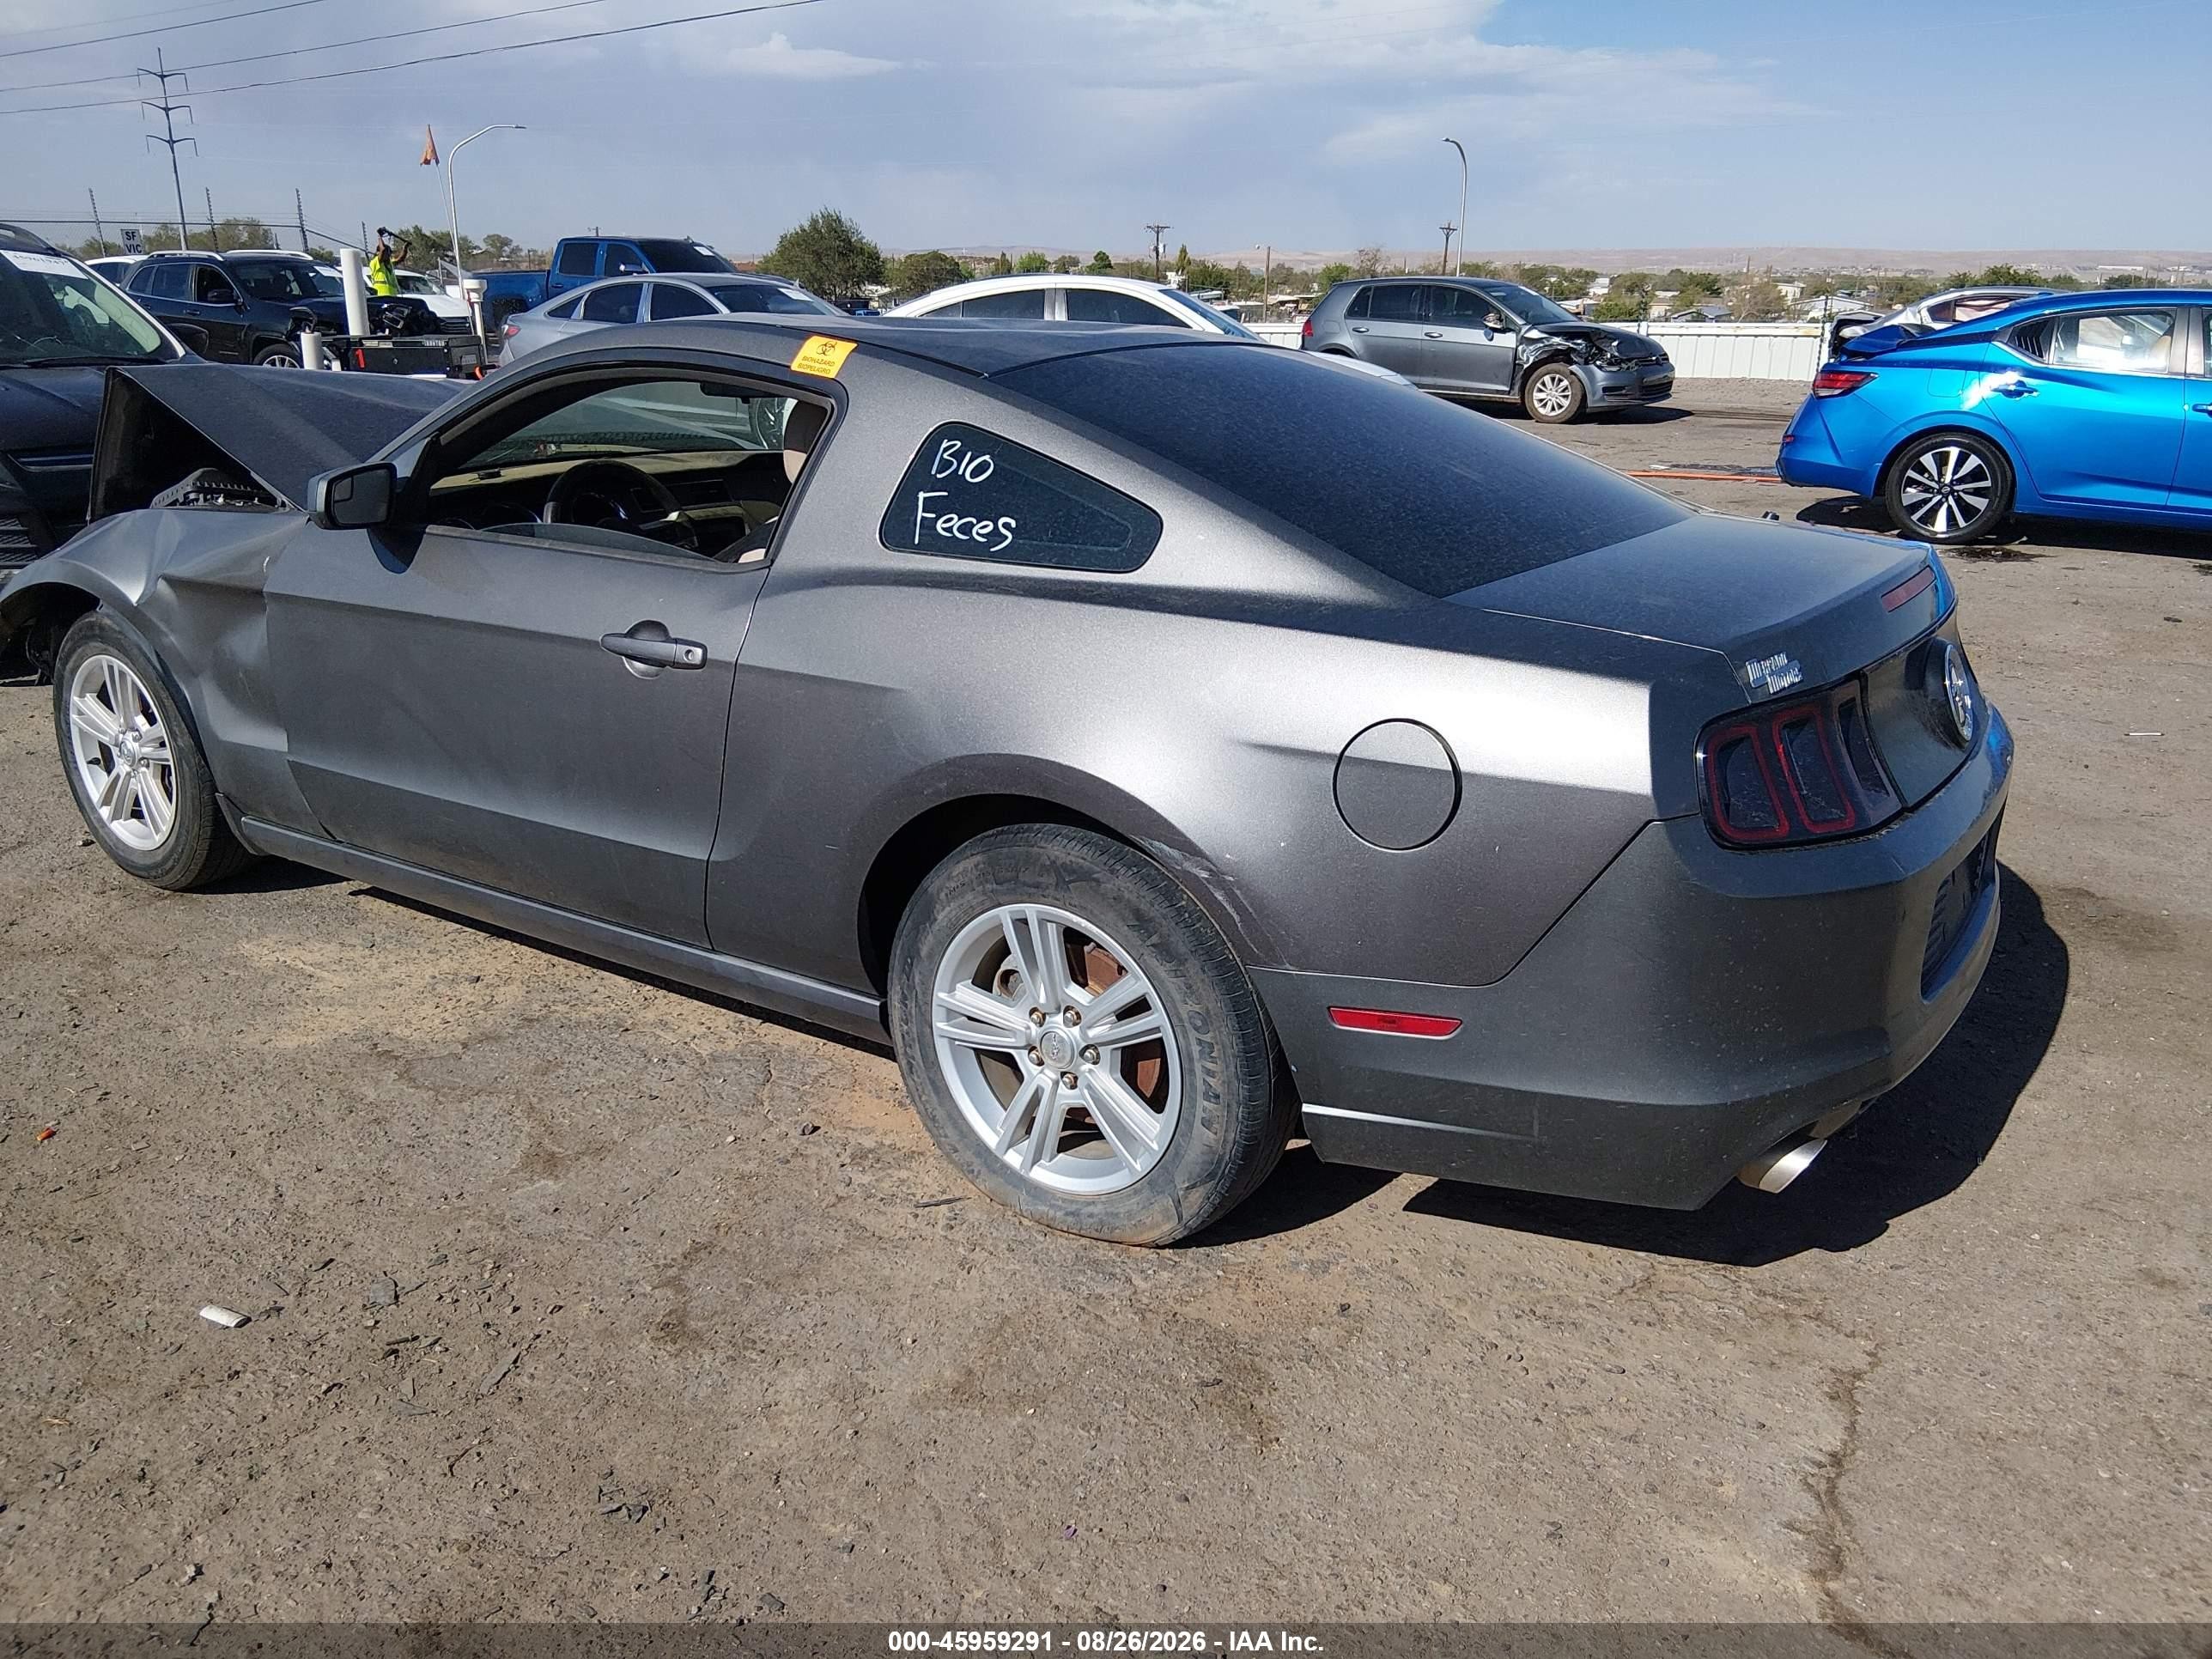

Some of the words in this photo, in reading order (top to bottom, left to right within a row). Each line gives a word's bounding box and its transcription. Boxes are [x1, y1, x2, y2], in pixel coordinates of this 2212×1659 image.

[125, 231, 137, 241] SF
[125, 243, 143, 254] VIC
[797, 362, 831, 374] BIOPELIGRO
[801, 356, 836, 368] BIOHAZARD
[931, 439, 994, 483] BIO
[915, 491, 1017, 551] Feces
